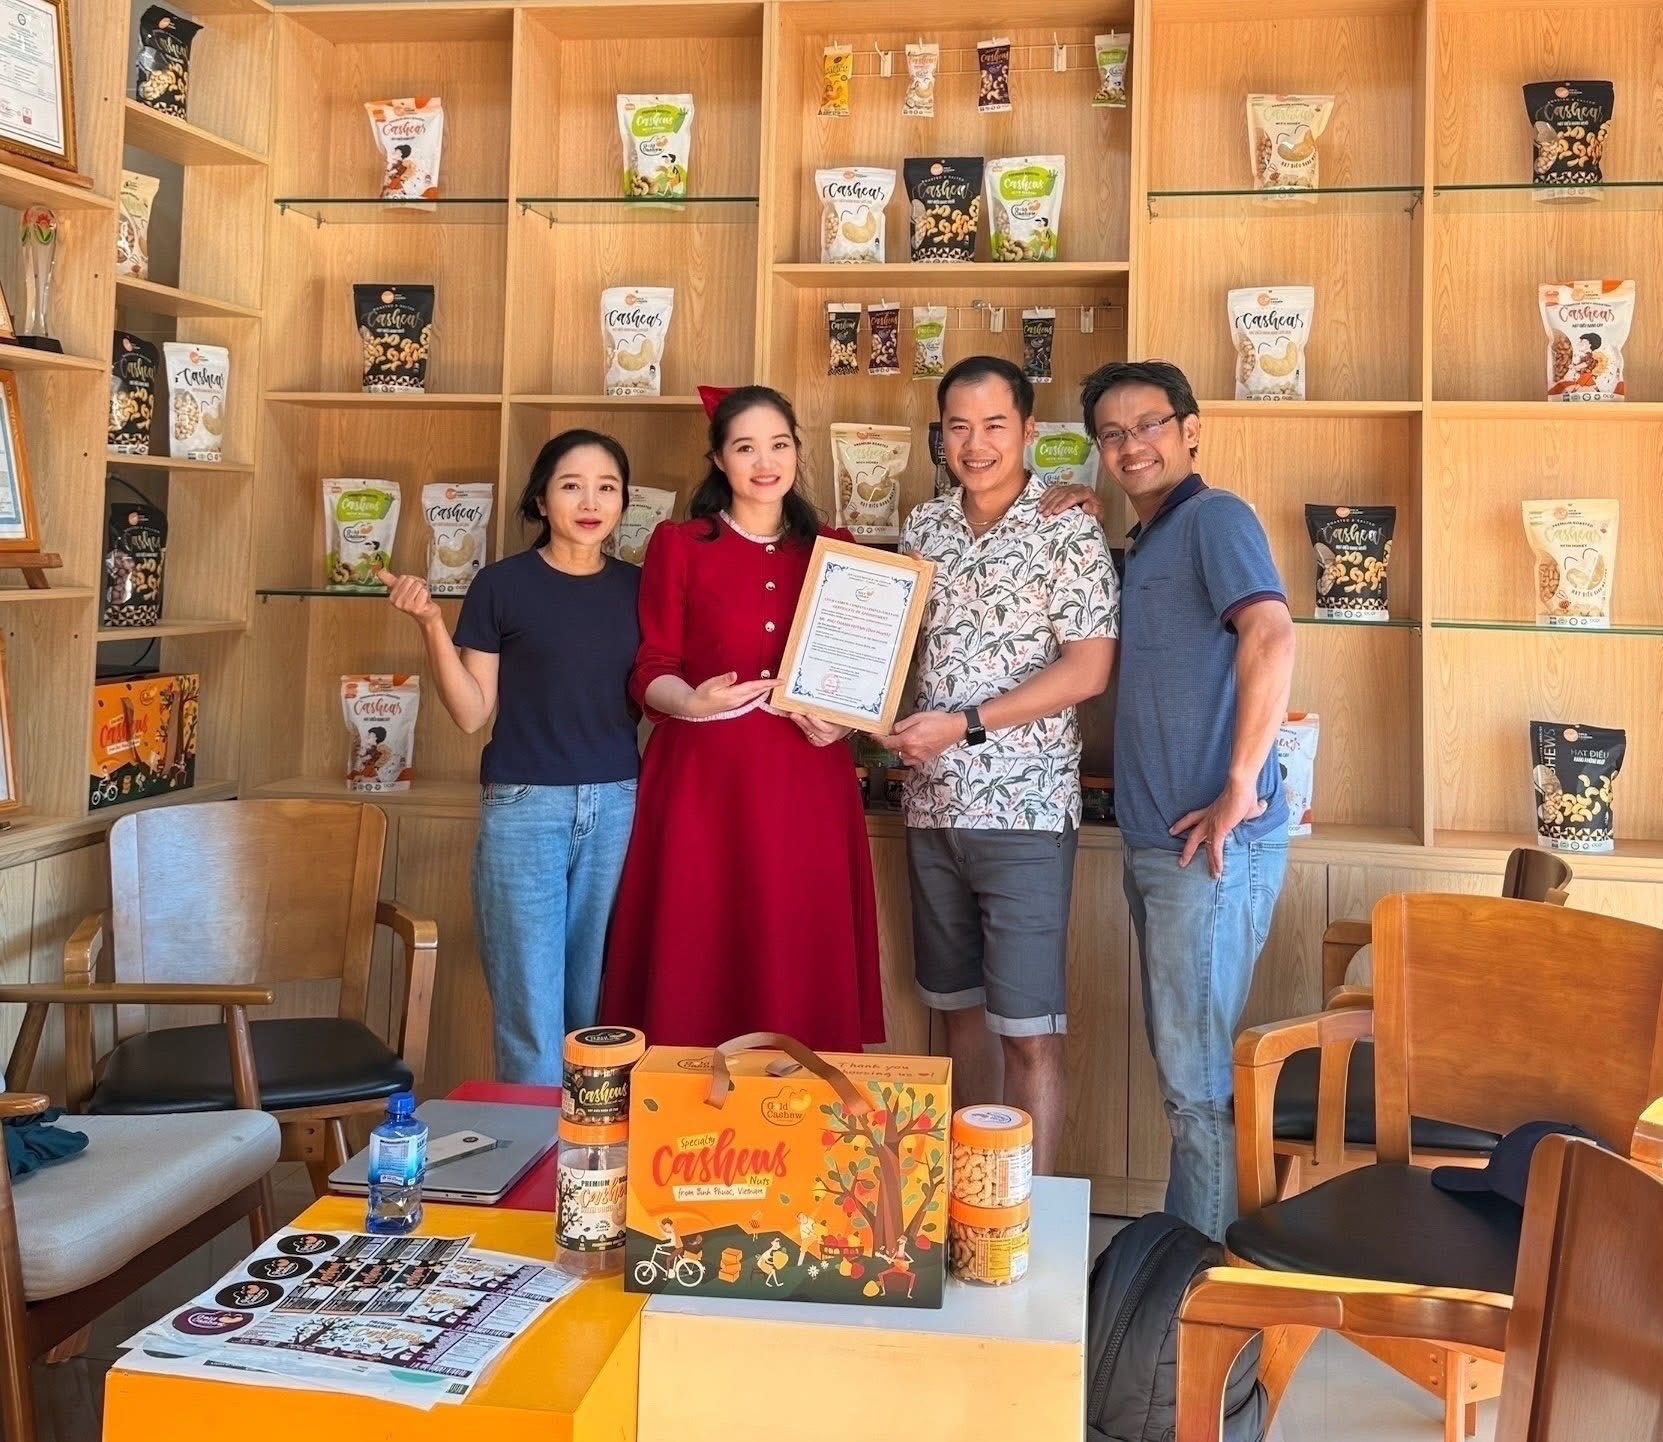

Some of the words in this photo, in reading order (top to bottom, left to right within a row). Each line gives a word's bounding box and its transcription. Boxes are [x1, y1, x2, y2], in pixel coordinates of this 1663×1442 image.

[823, 182, 885, 201] Cashews
[605, 309, 662, 327] Cashews
[1236, 310, 1304, 330] Cashews
[1559, 306, 1615, 322] Cashews
[427, 503, 483, 522] Cashews
[354, 699, 402, 715] Cashews
[842, 1069, 892, 1078] hoosing
[579, 1081, 629, 1104] Cashews
[767, 1110, 803, 1119] Cashew
[681, 1135, 716, 1149] Specialty
[652, 1127, 791, 1187] Cashews
[581, 1179, 610, 1187] PREMIUM
[750, 1175, 770, 1186] Nuts
[678, 1188, 694, 1197] from
[737, 1187, 764, 1196] Vietnam
